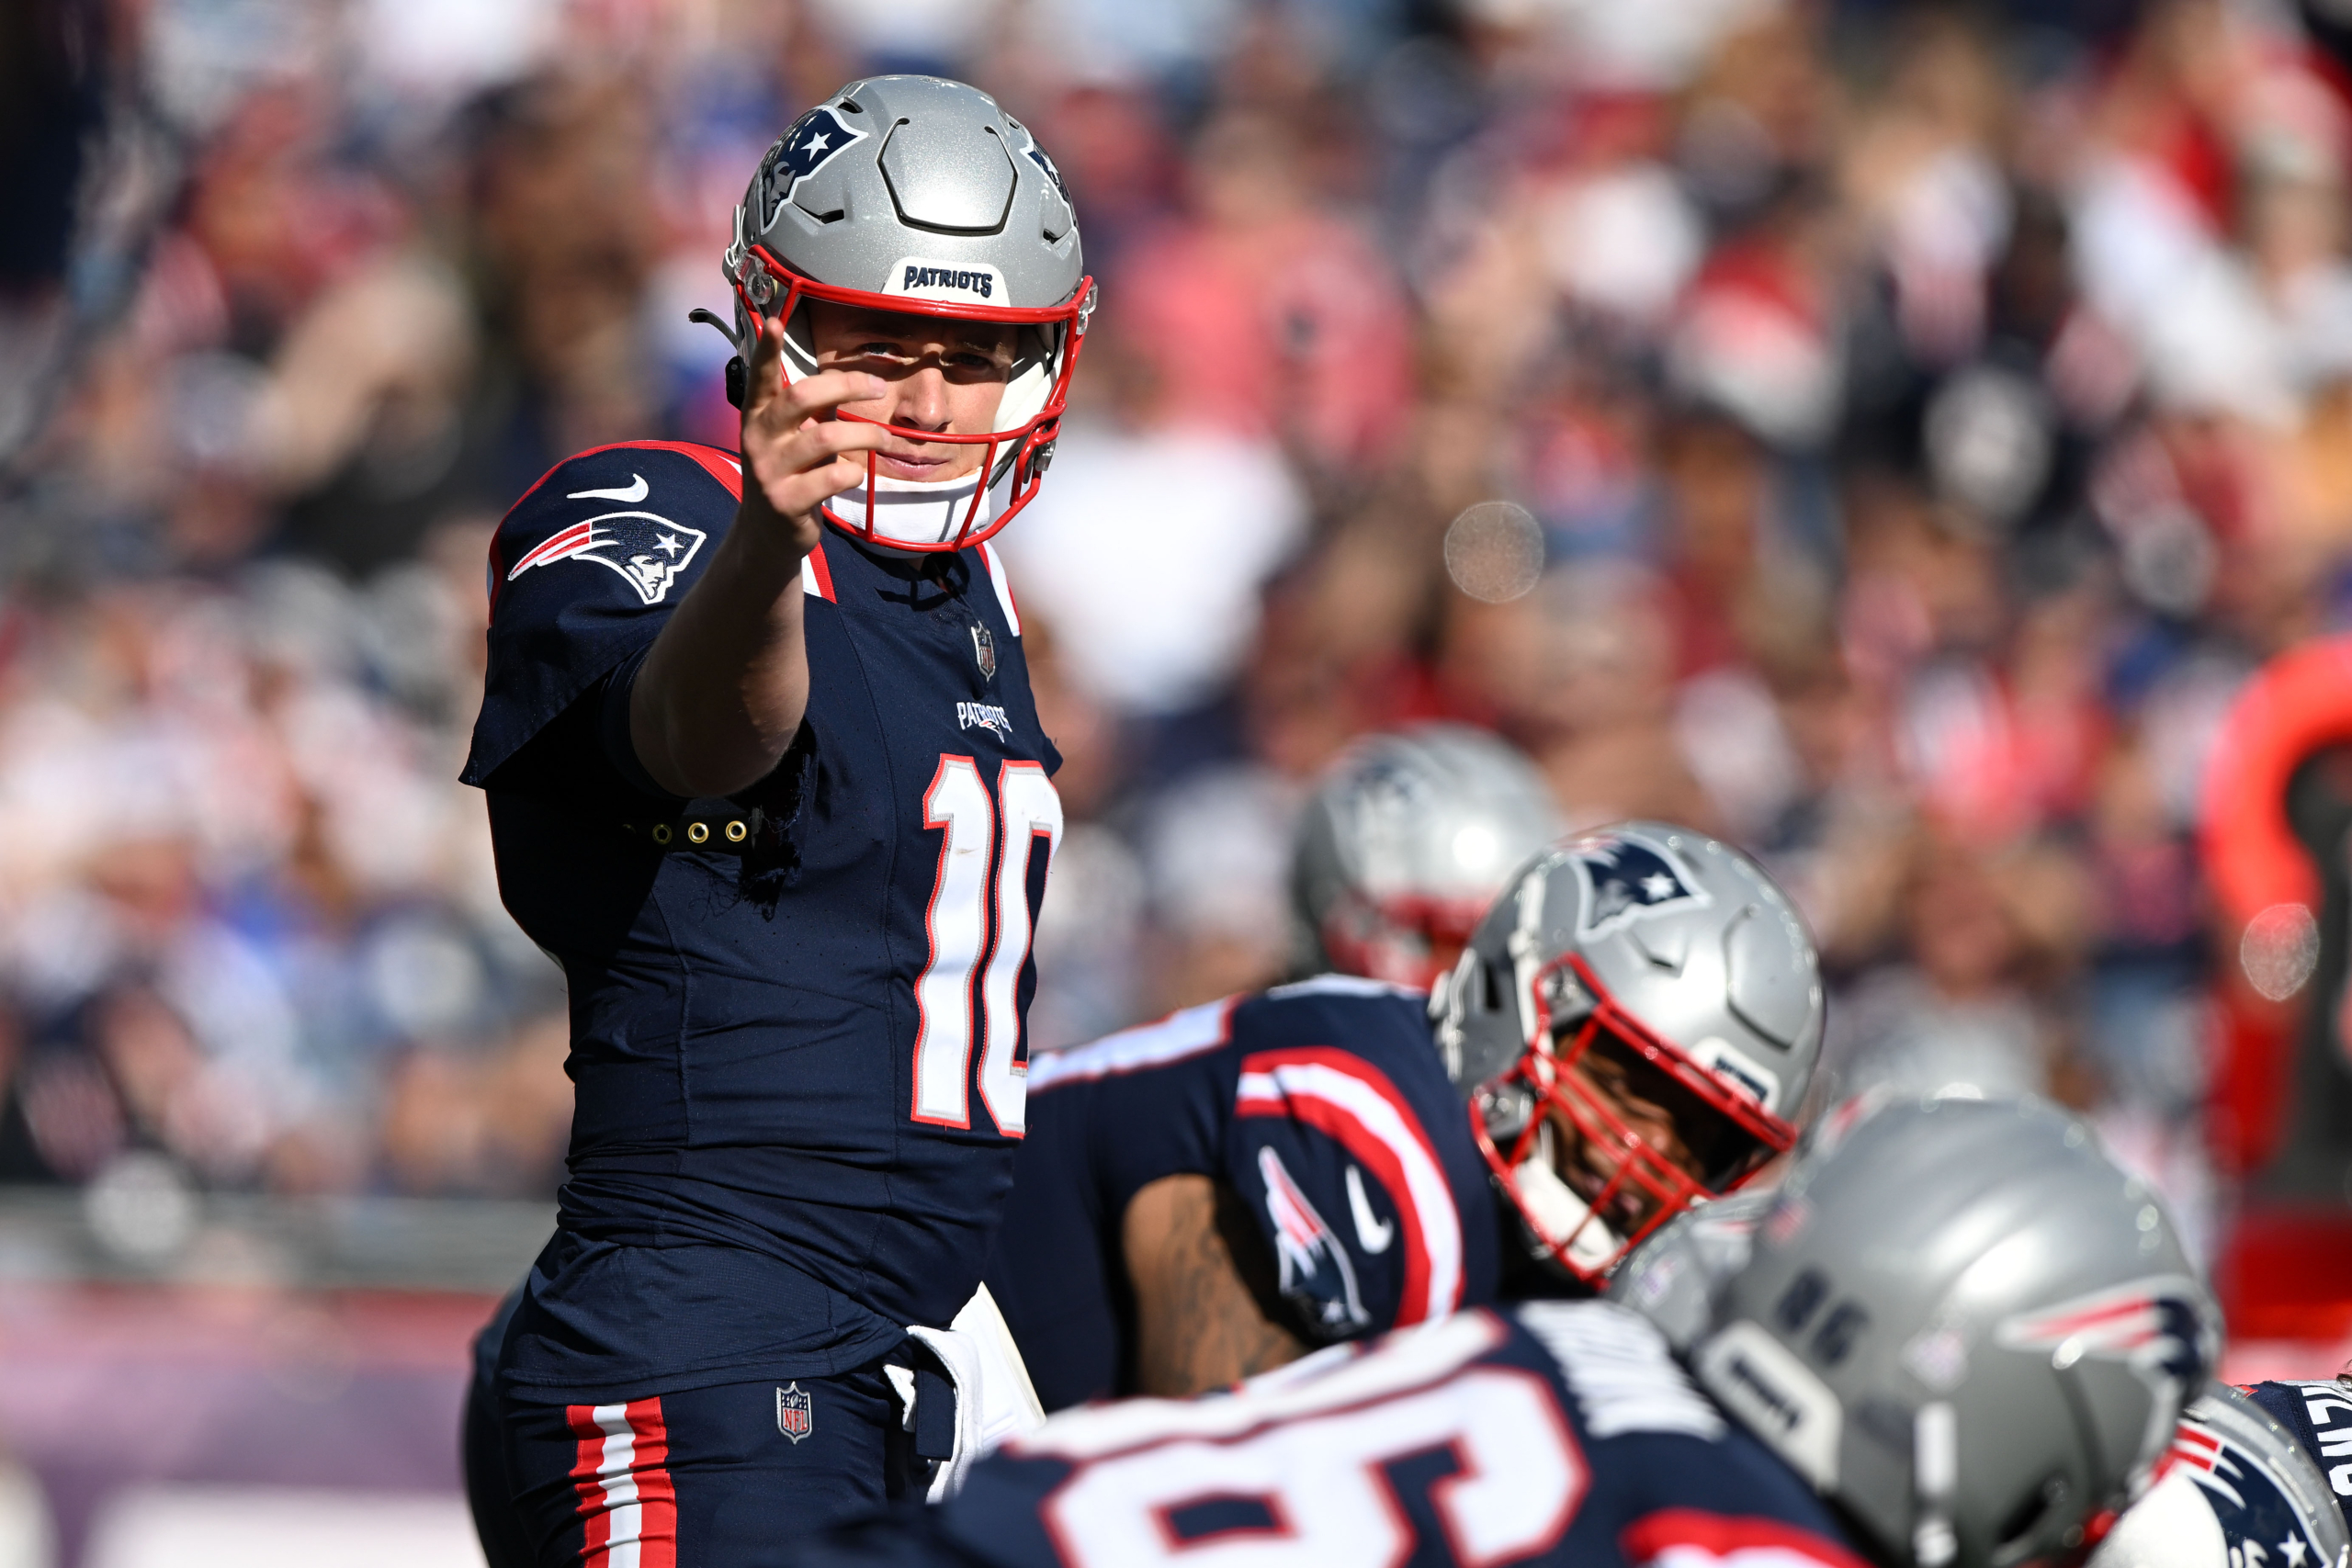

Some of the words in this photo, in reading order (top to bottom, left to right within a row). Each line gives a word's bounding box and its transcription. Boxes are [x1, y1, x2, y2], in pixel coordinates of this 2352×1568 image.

[903, 265, 993, 299] PATRIOTS
[956, 702, 1012, 732] PATRIOTS
[910, 753, 1063, 1139] 10
[783, 1408, 808, 1433] NFL
